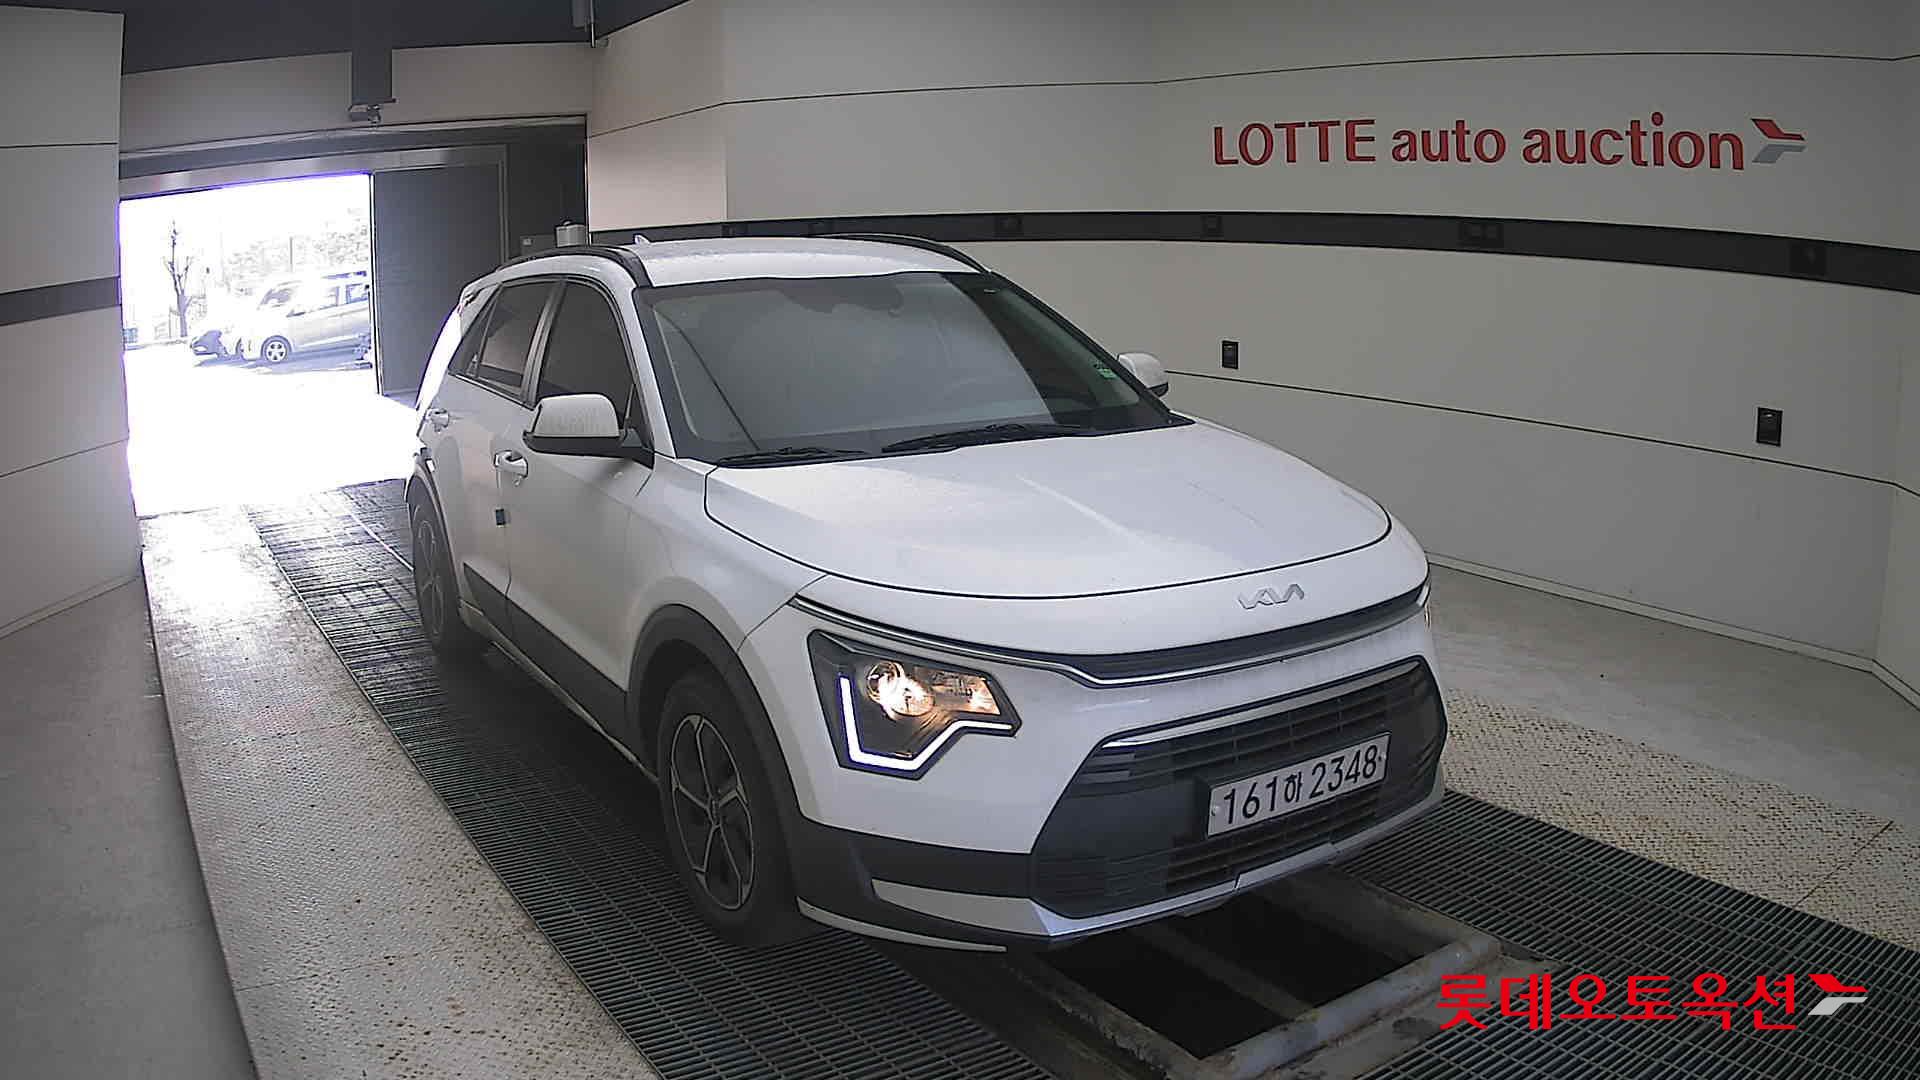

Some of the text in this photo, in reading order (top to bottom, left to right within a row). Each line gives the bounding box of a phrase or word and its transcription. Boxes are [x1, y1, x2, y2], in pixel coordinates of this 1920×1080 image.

[1213, 111, 1744, 170] LOTTE auto auction
